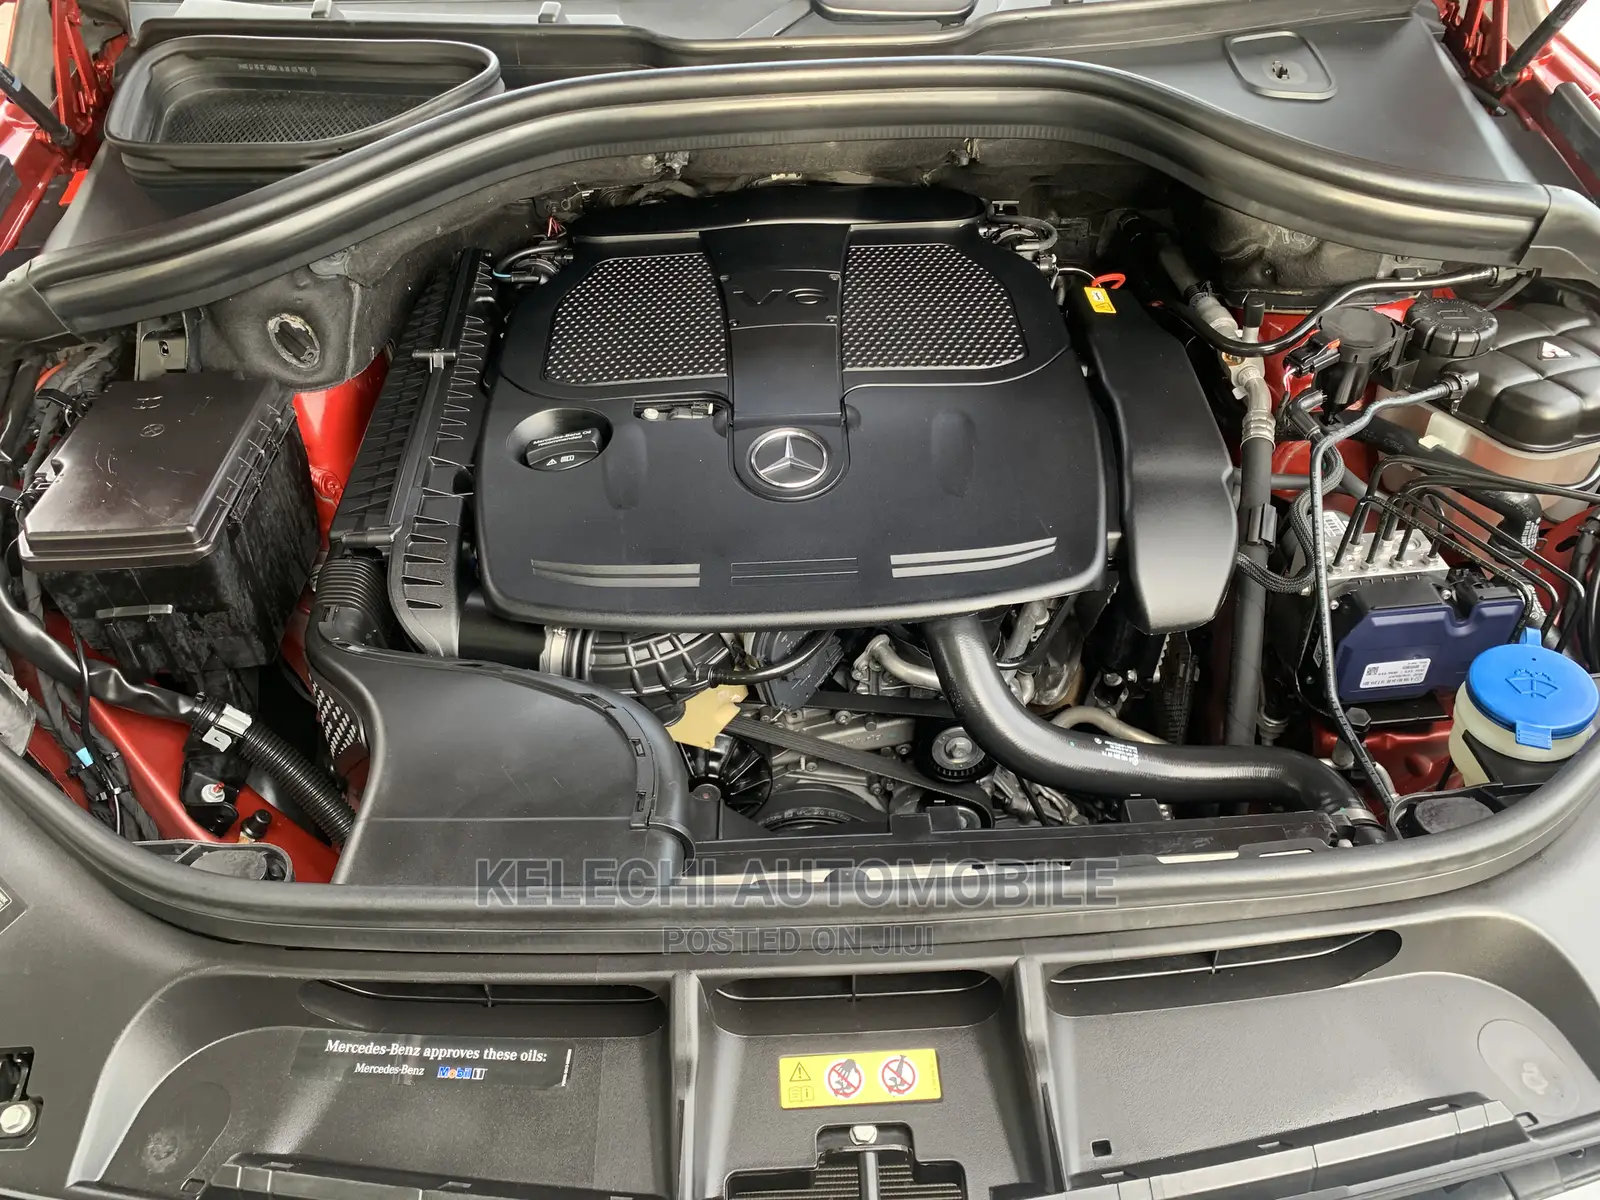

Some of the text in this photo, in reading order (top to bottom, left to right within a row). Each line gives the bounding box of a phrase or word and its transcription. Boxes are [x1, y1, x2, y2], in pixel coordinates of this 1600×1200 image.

[733, 287, 828, 306] V6
[324, 1039, 547, 1062] Mercedes-Benz approves these oils:
[354, 1062, 425, 1076] Mercedes-Benz
[437, 1066, 472, 1079] Mobil
